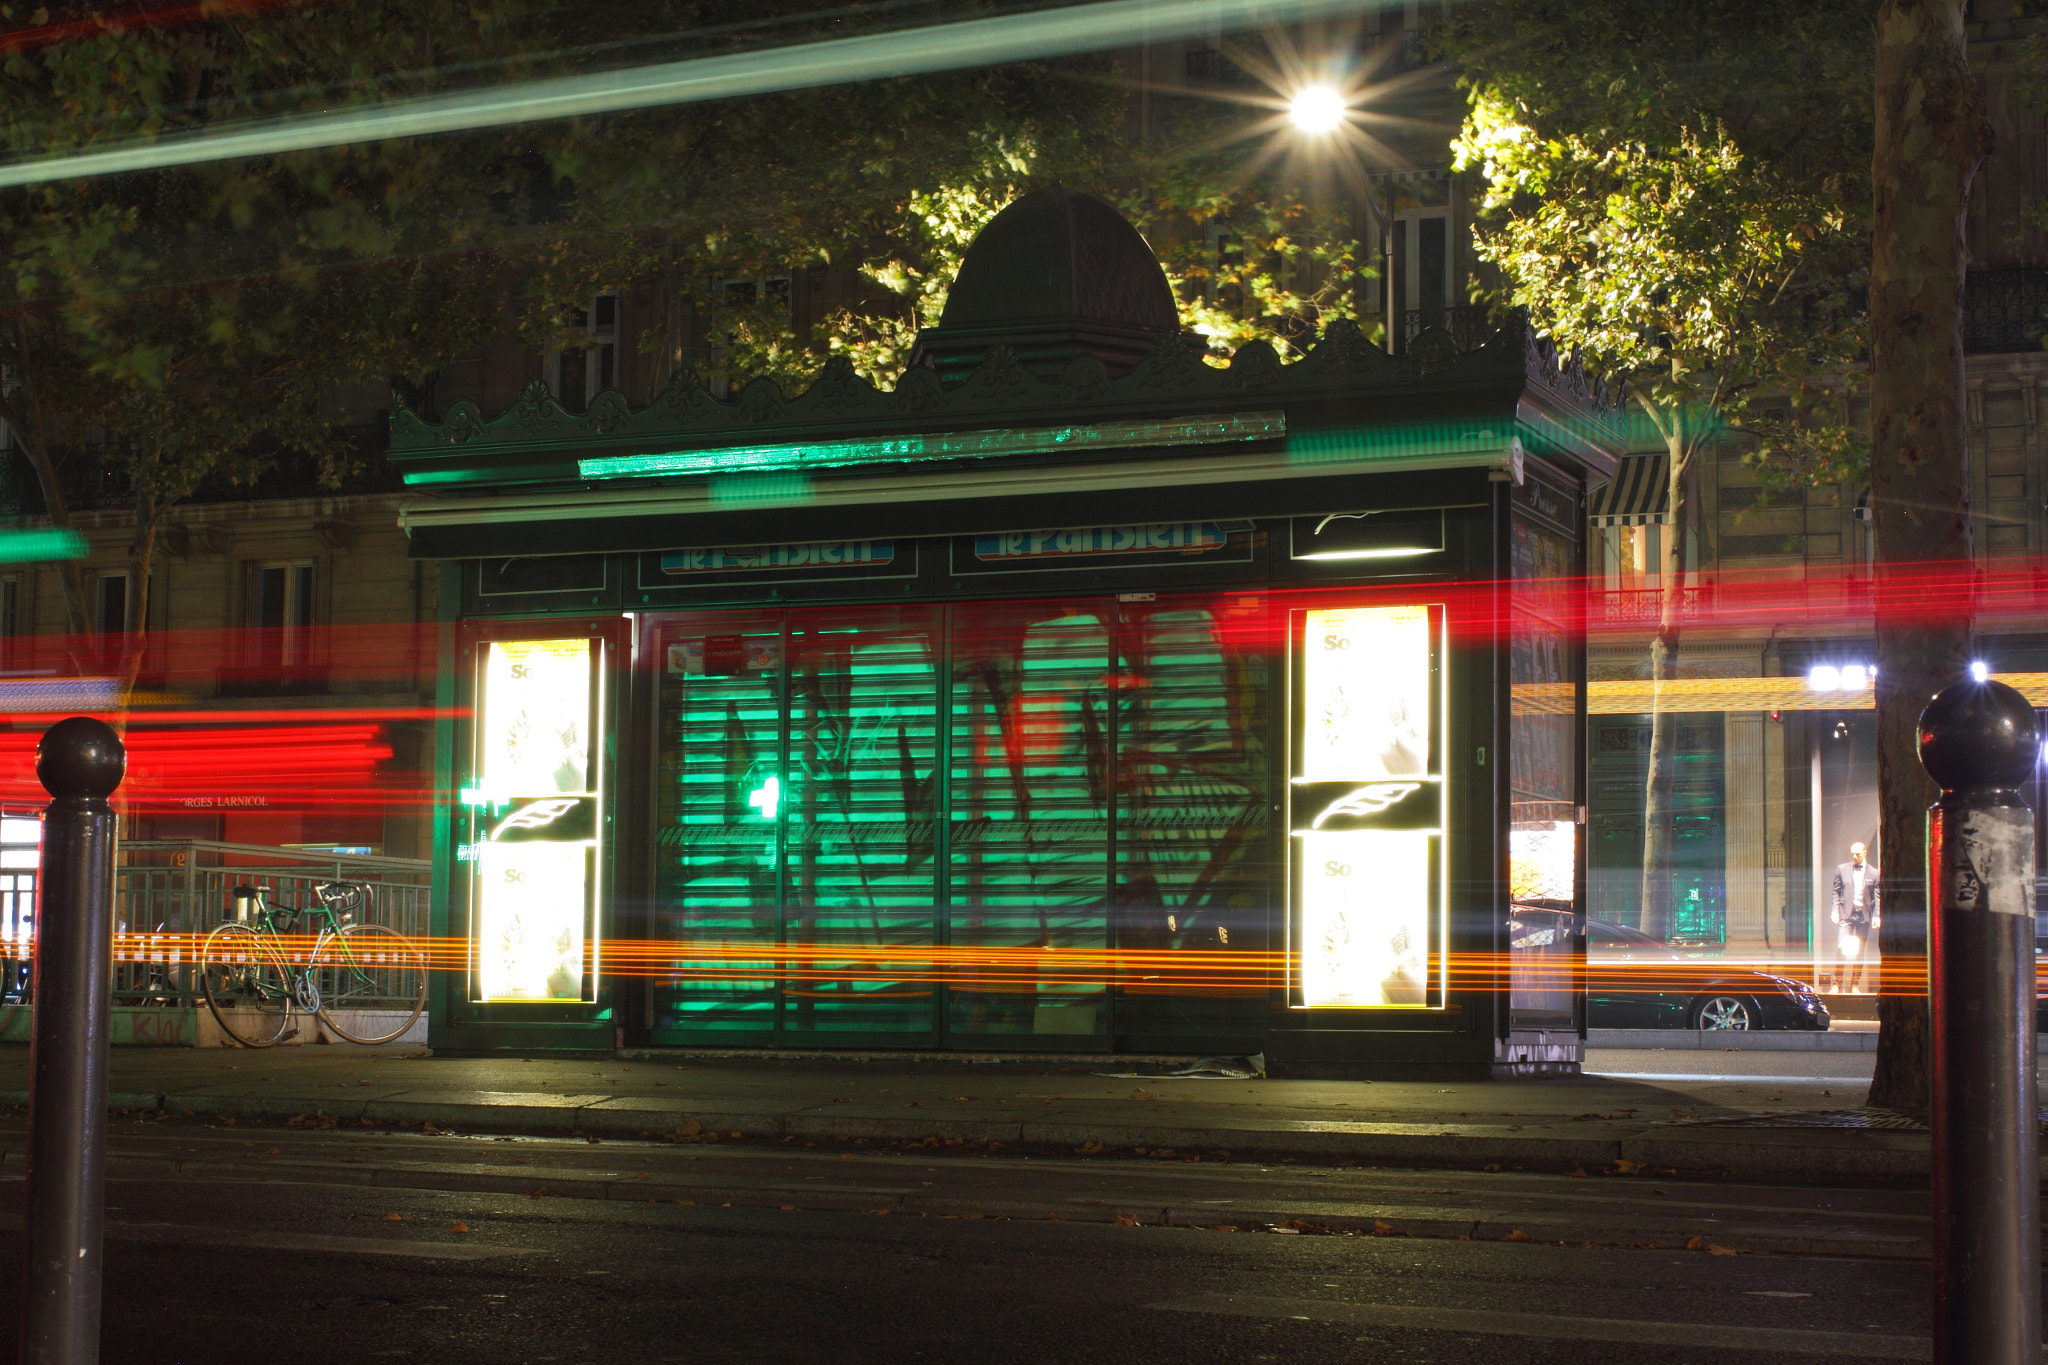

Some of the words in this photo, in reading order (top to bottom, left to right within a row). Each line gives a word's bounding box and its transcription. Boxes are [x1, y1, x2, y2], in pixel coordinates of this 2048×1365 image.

[1529, 481, 1558, 518] Presse
[1324, 634, 1351, 651] So
[511, 663, 534, 680] So
[217, 795, 269, 807] LARNICOL
[505, 868, 528, 884] So
[1325, 860, 1352, 877] So
